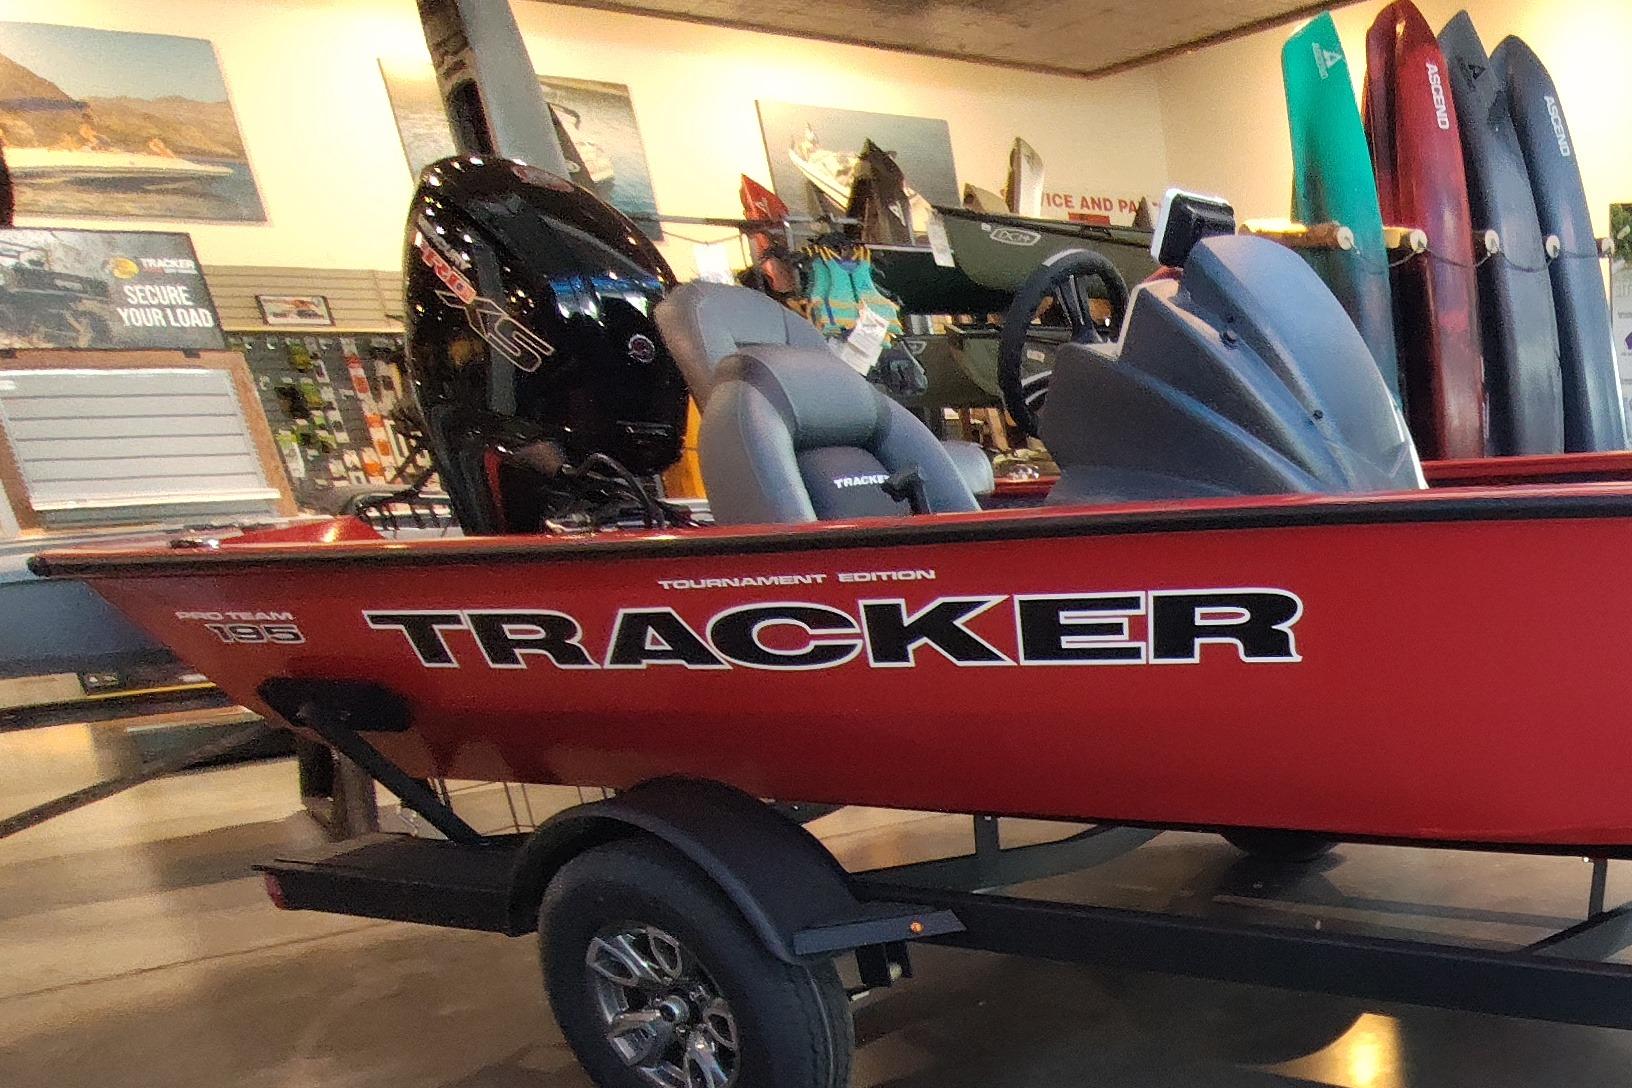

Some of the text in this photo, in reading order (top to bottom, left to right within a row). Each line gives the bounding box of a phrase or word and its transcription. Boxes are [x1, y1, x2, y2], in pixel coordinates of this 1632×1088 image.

[1426, 61, 1450, 130] ASCEND
[1544, 95, 1570, 158] ASCEND
[1080, 196, 1114, 212] AND
[140, 257, 195, 269] TRACKER
[123, 285, 194, 306] SECURE
[116, 307, 215, 328] YOUR LOAD
[657, 569, 937, 590] TOURNAMENT EDITION
[175, 611, 297, 621] PRO TEAM
[204, 623, 306, 644] 195
[362, 588, 1304, 671] TRACKER
